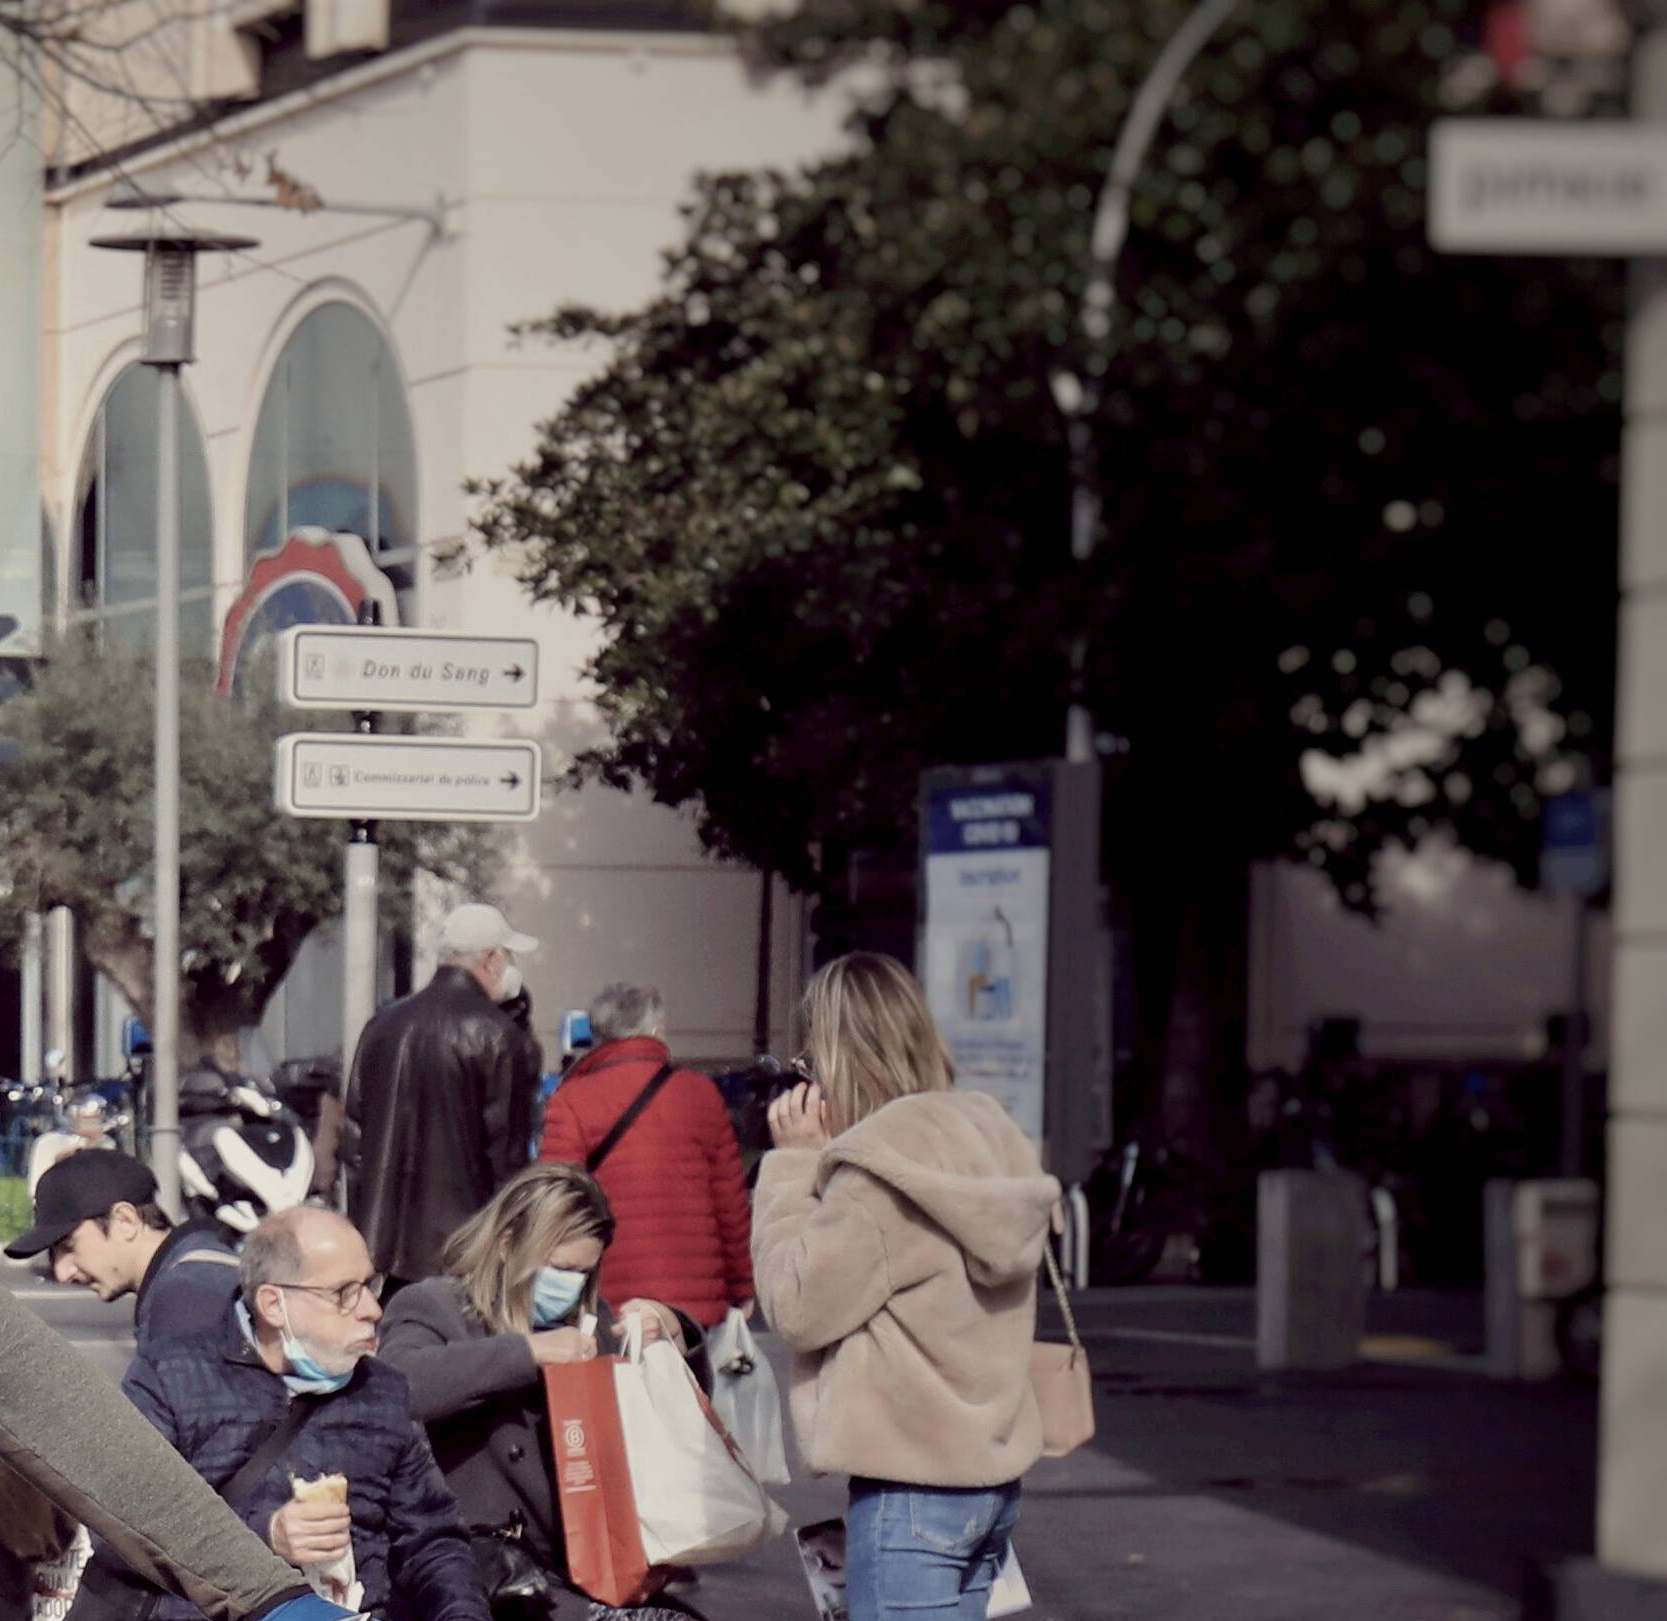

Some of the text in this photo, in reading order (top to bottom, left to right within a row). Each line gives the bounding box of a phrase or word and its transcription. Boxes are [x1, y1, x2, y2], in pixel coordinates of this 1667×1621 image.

[362, 659, 490, 686] Don du Sang
[354, 771, 491, 788] Commissariat de police
